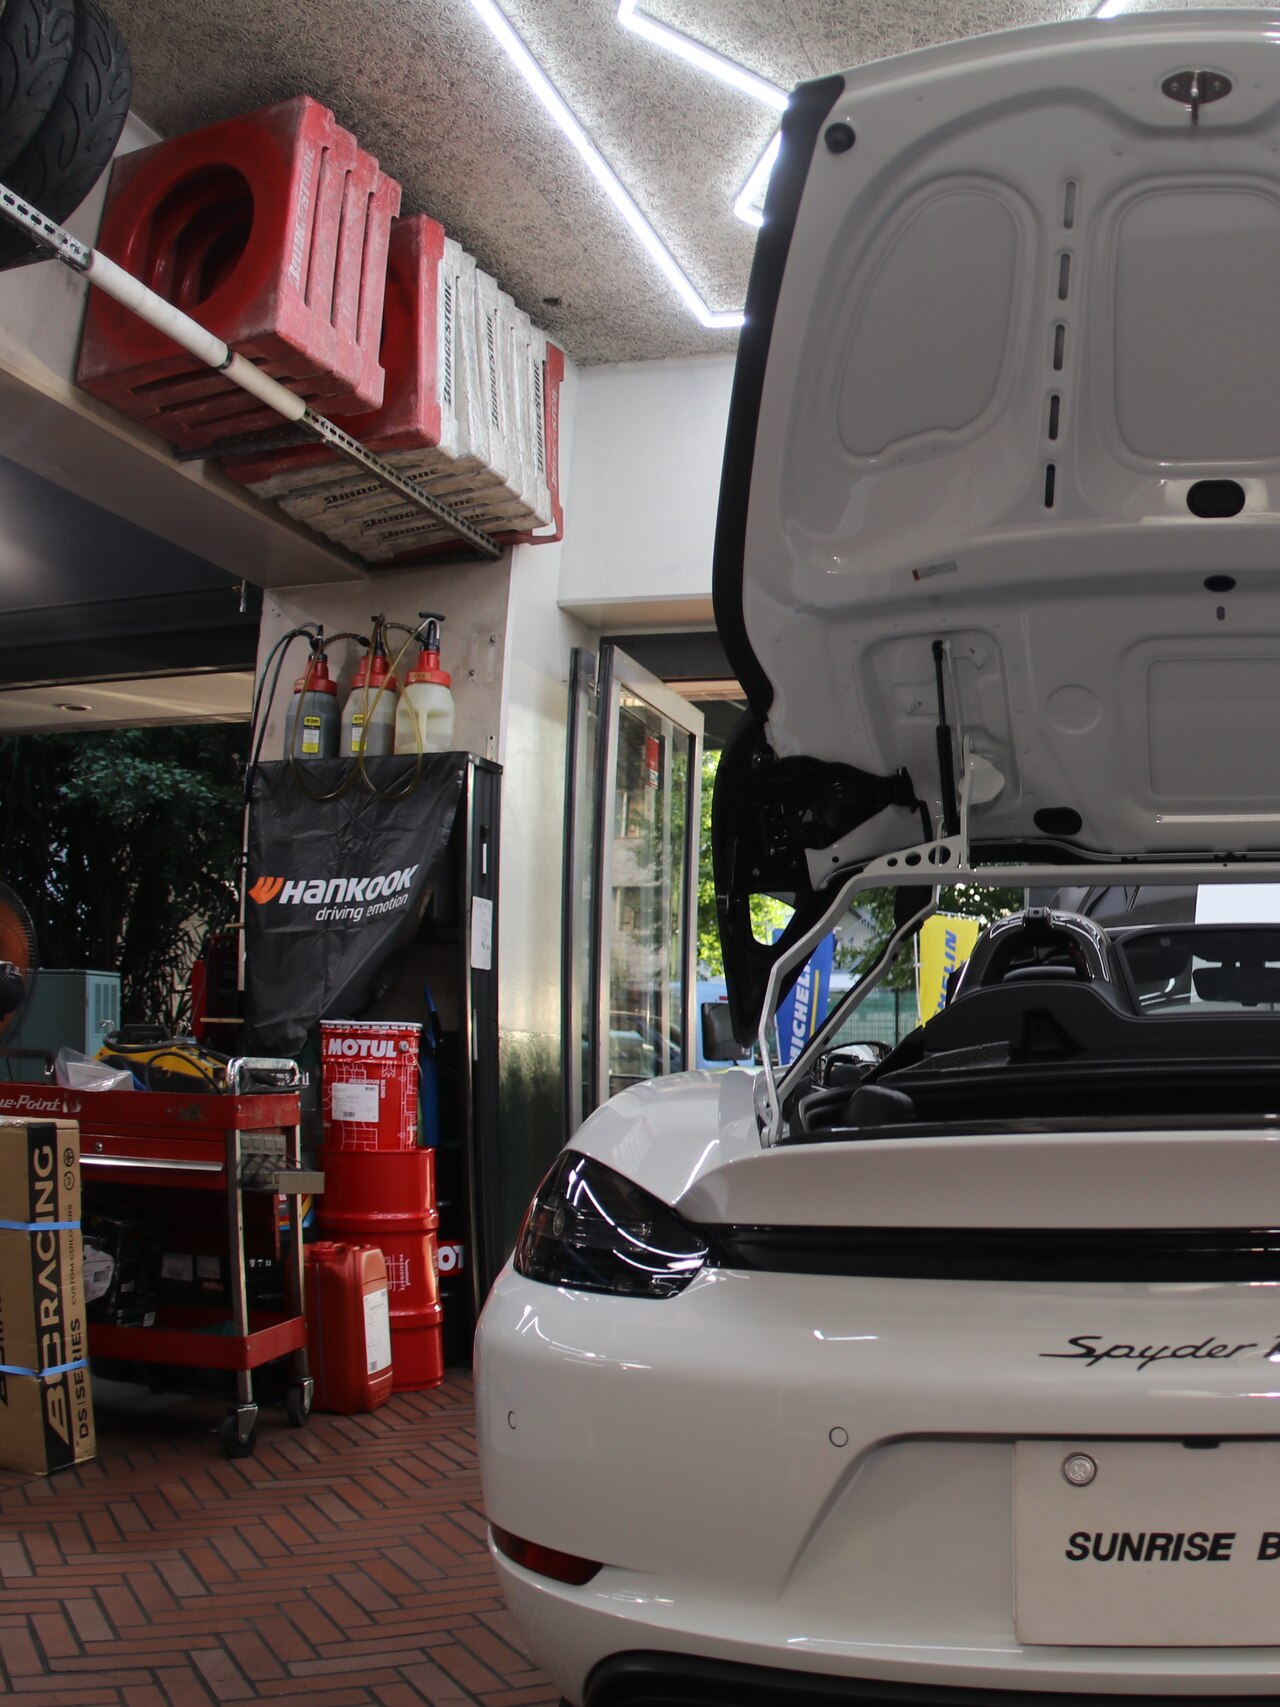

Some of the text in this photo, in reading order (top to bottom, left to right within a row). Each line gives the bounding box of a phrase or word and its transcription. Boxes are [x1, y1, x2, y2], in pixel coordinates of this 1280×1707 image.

[315, 893, 409, 922] driving emotion
[327, 1038, 397, 1058] MOTUL
[1039, 1336, 1258, 1371] Spyder
[1065, 1531, 1236, 1562] SUNRISE
